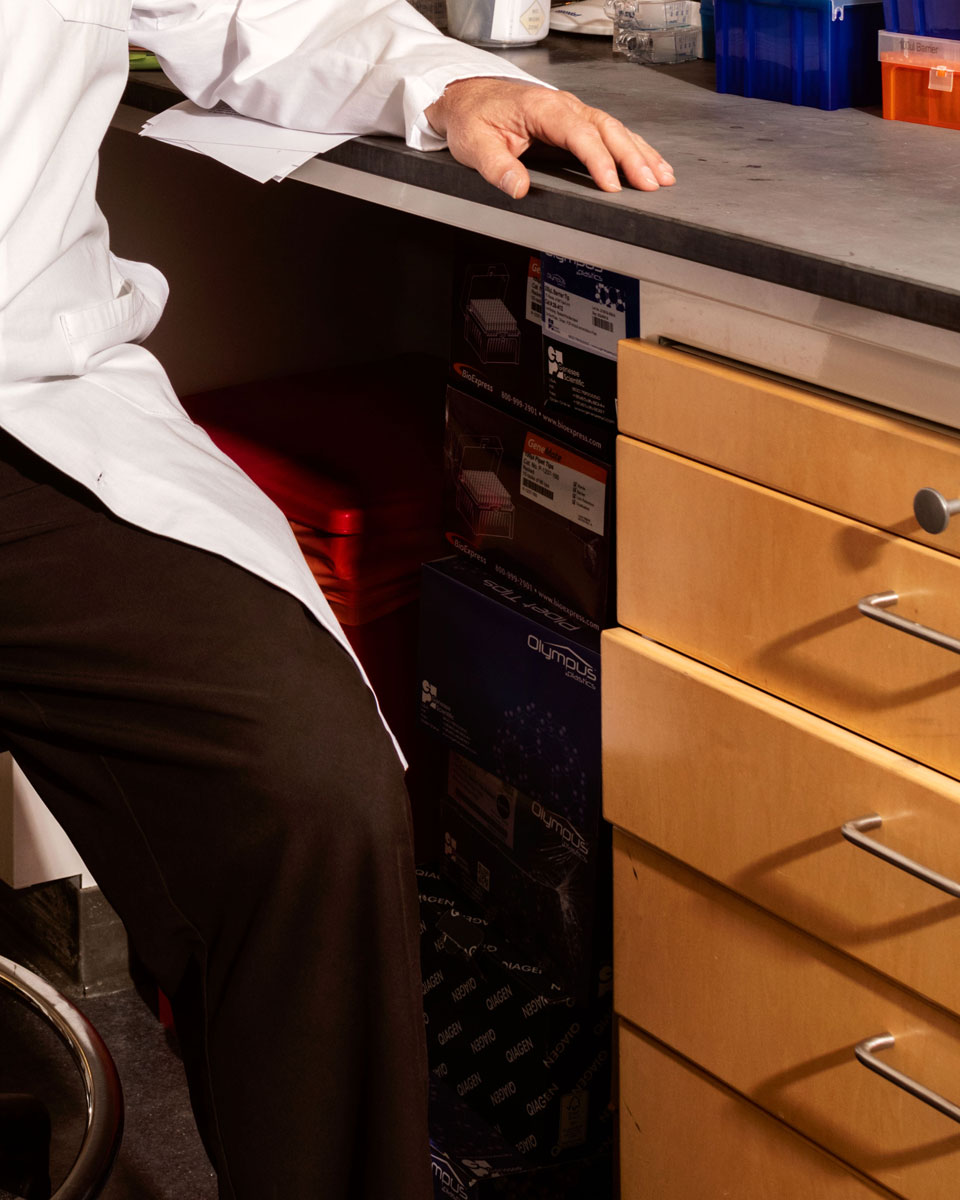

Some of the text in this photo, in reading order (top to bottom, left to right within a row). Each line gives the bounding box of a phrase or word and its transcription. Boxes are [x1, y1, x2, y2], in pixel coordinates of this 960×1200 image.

[916, 42, 938, 54] Barrier
[461, 369, 494, 393] BioExpress
[542, 414, 602, 450] www.bioexpress.com
[527, 438, 562, 461] GeneMate
[454, 539, 488, 565] BioExpress
[539, 590, 601, 632] www.bioexpress.com
[527, 634, 597, 682] Olympus
[565, 671, 597, 691] plastics
[531, 800, 589, 856] Olympus
[485, 984, 513, 1012] QIAGEN
[437, 1019, 464, 1046] QIAGEN
[505, 1036, 535, 1064] QIAGEN
[456, 1071, 483, 1097] QIAGEN
[525, 1081, 561, 1118] QIAGEN
